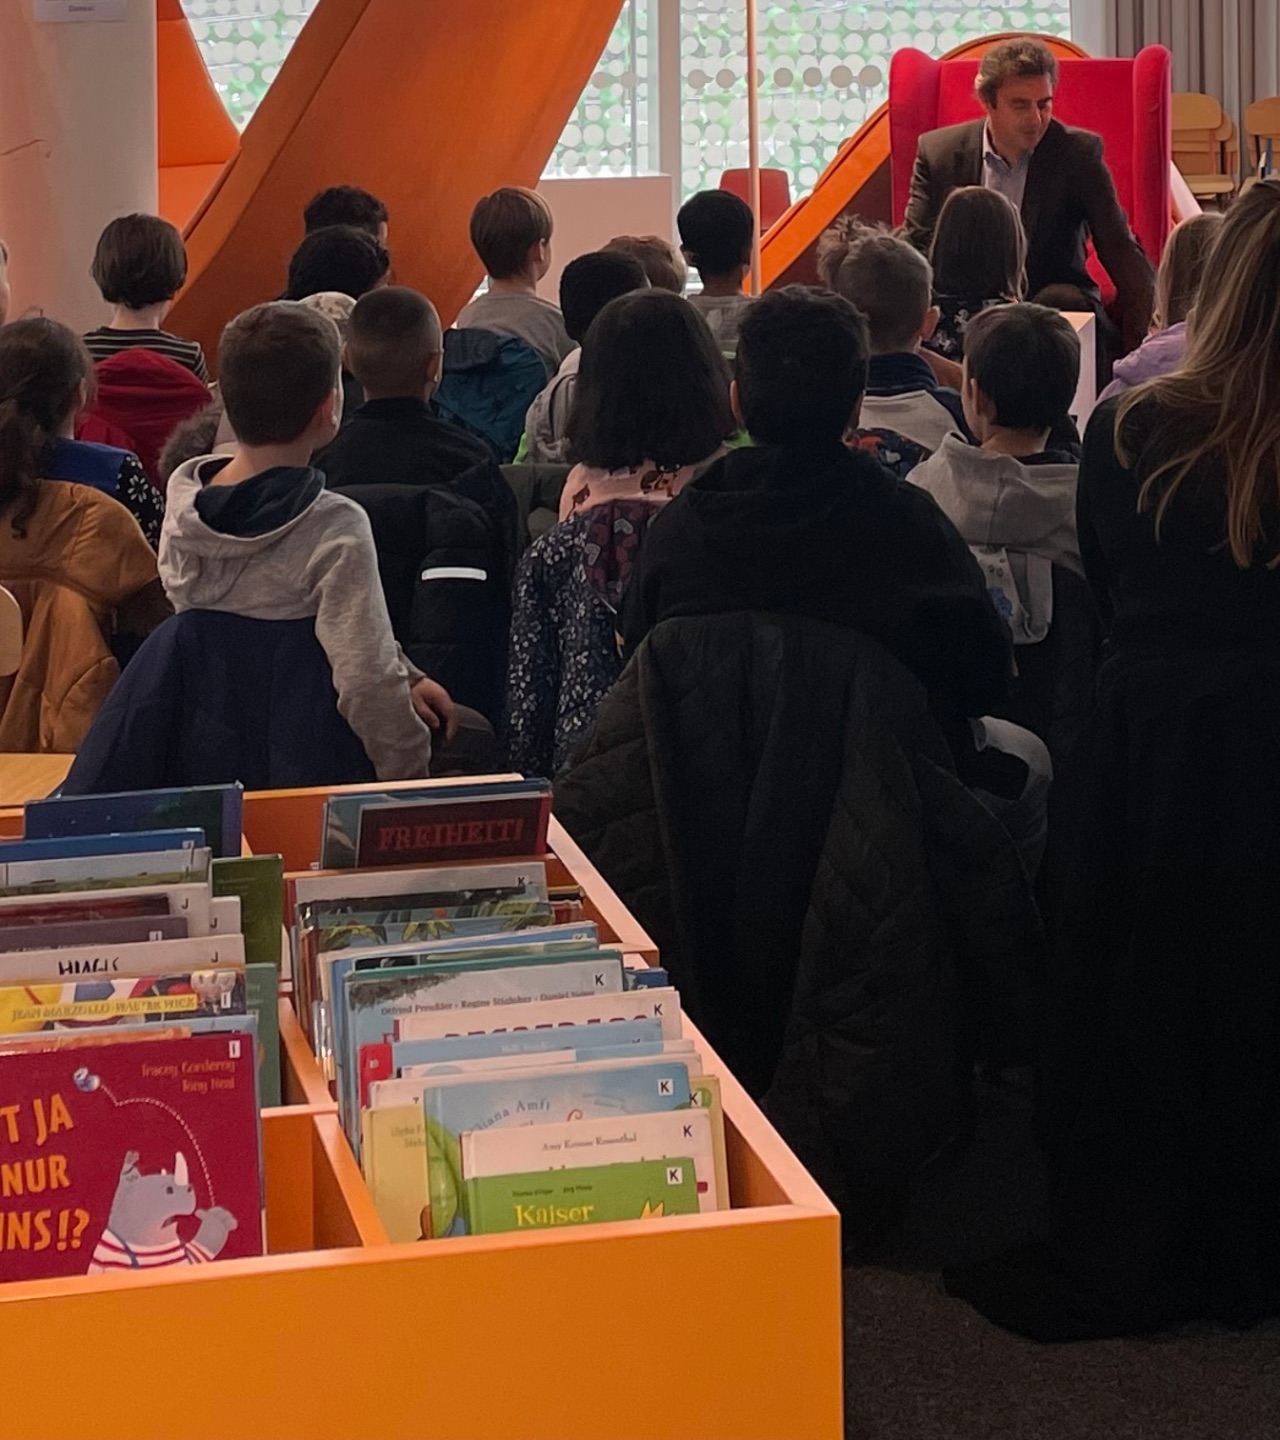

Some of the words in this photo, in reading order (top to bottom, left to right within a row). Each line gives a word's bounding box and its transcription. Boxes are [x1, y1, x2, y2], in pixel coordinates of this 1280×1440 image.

[377, 817, 525, 852] FREIHEIT!
[594, 973, 605, 987] K
[653, 1003, 663, 1017] K
[659, 1080, 670, 1094] K
[689, 1092, 699, 1105] K
[32, 1092, 75, 1147] JA
[682, 1124, 693, 1138] K
[0, 1154, 71, 1198] NUR
[669, 1169, 679, 1182] K
[513, 1203, 596, 1228] Kaiser
